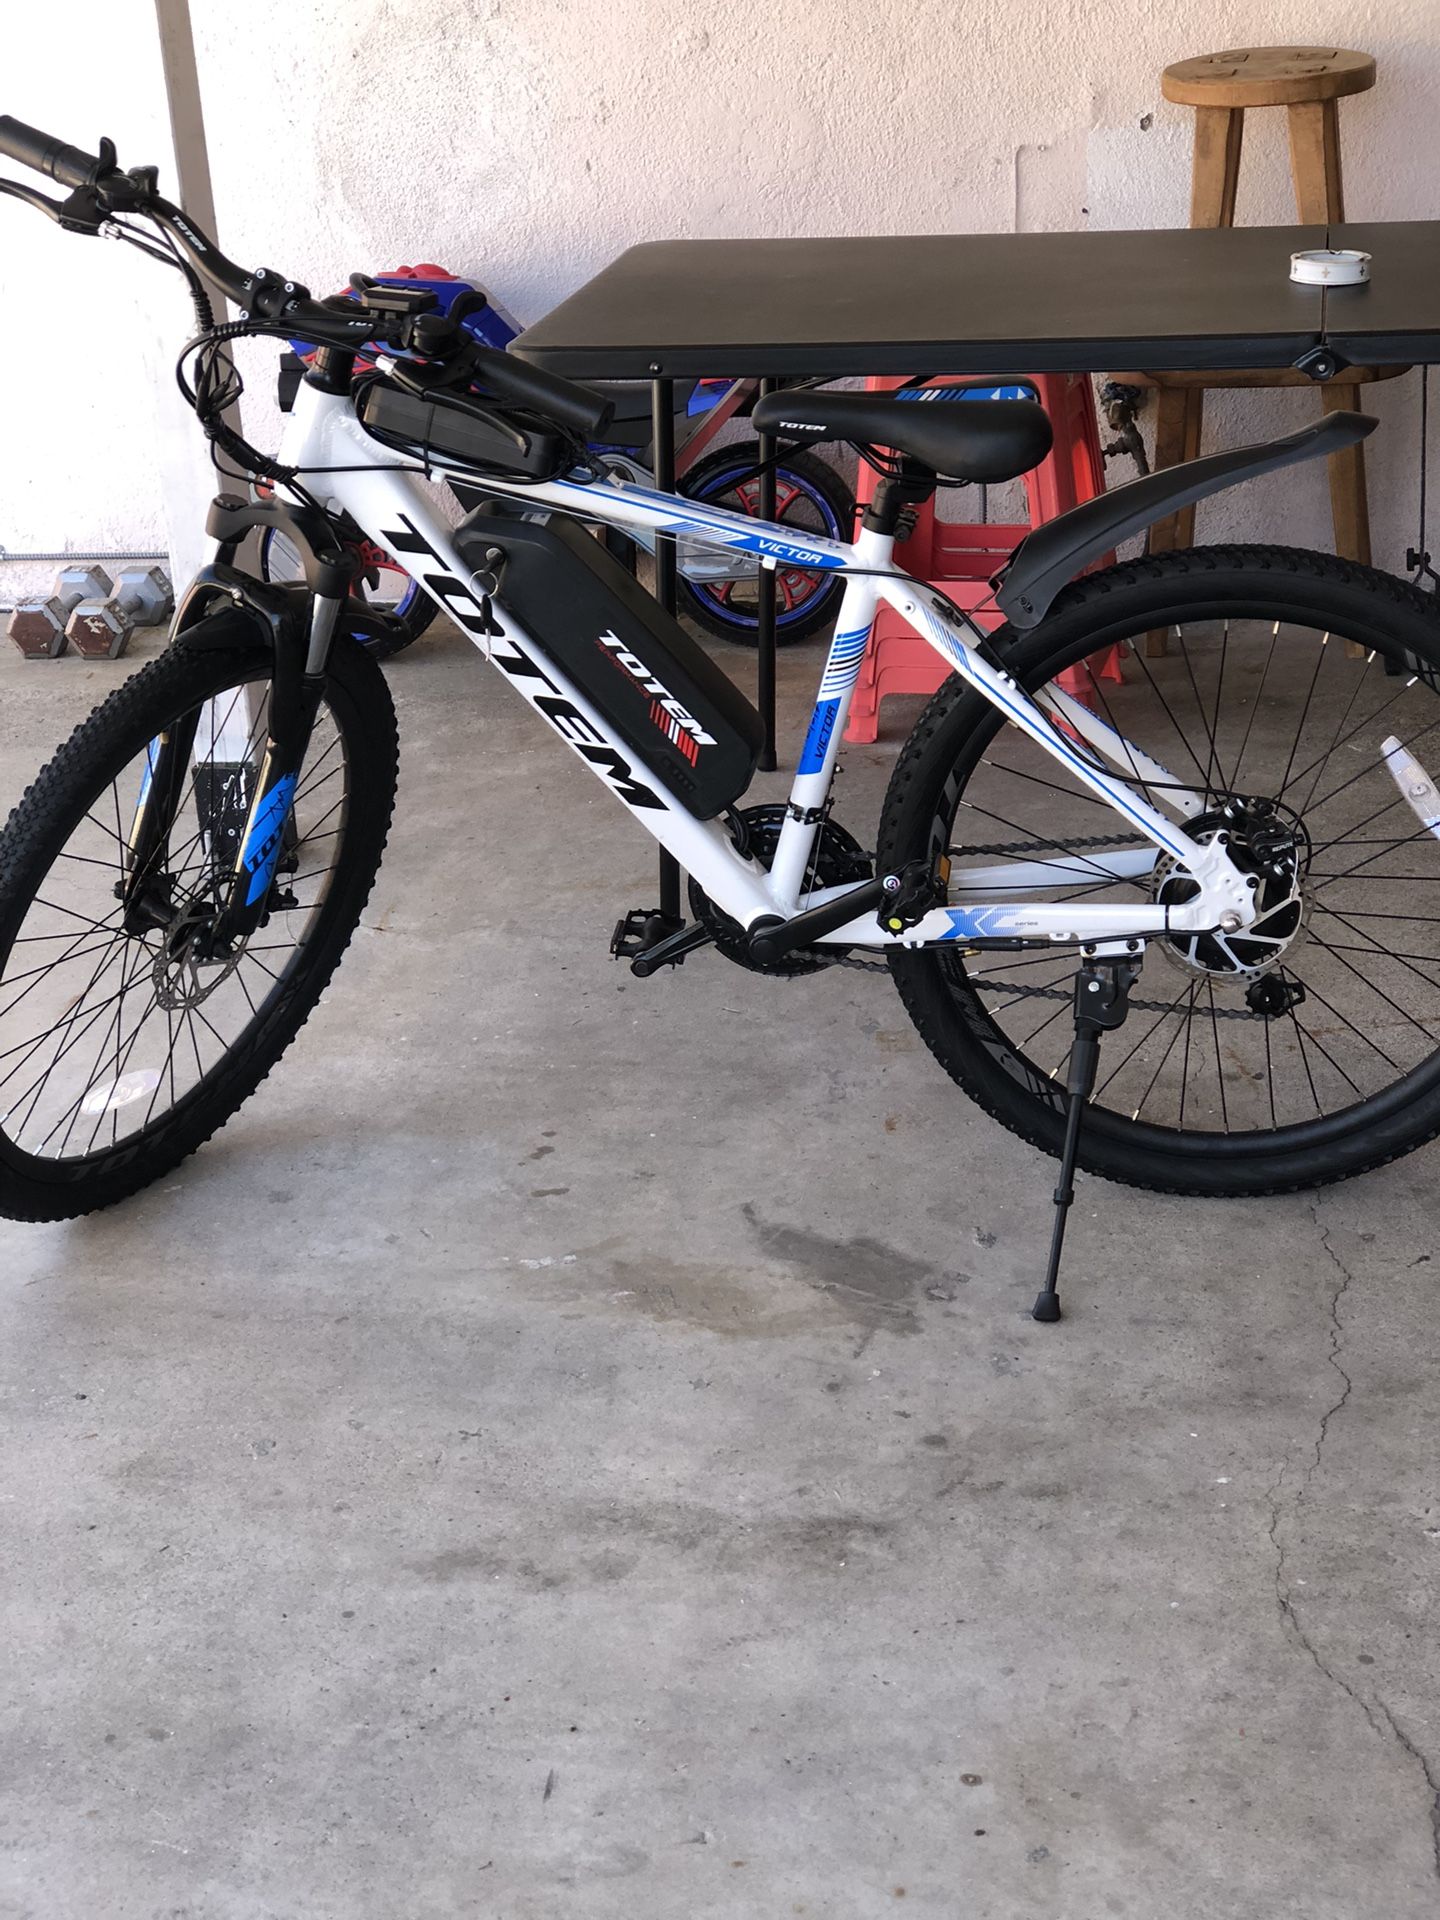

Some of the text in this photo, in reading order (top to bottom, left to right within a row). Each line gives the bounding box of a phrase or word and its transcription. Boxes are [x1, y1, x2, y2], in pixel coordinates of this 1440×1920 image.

[779, 421, 827, 431] TOTEM
[758, 539, 823, 564] VICTOR
[381, 513, 670, 811] TOTEM
[599, 629, 718, 745] TOTEM
[814, 704, 837, 758] VICTOR
[937, 905, 1030, 940] XC
